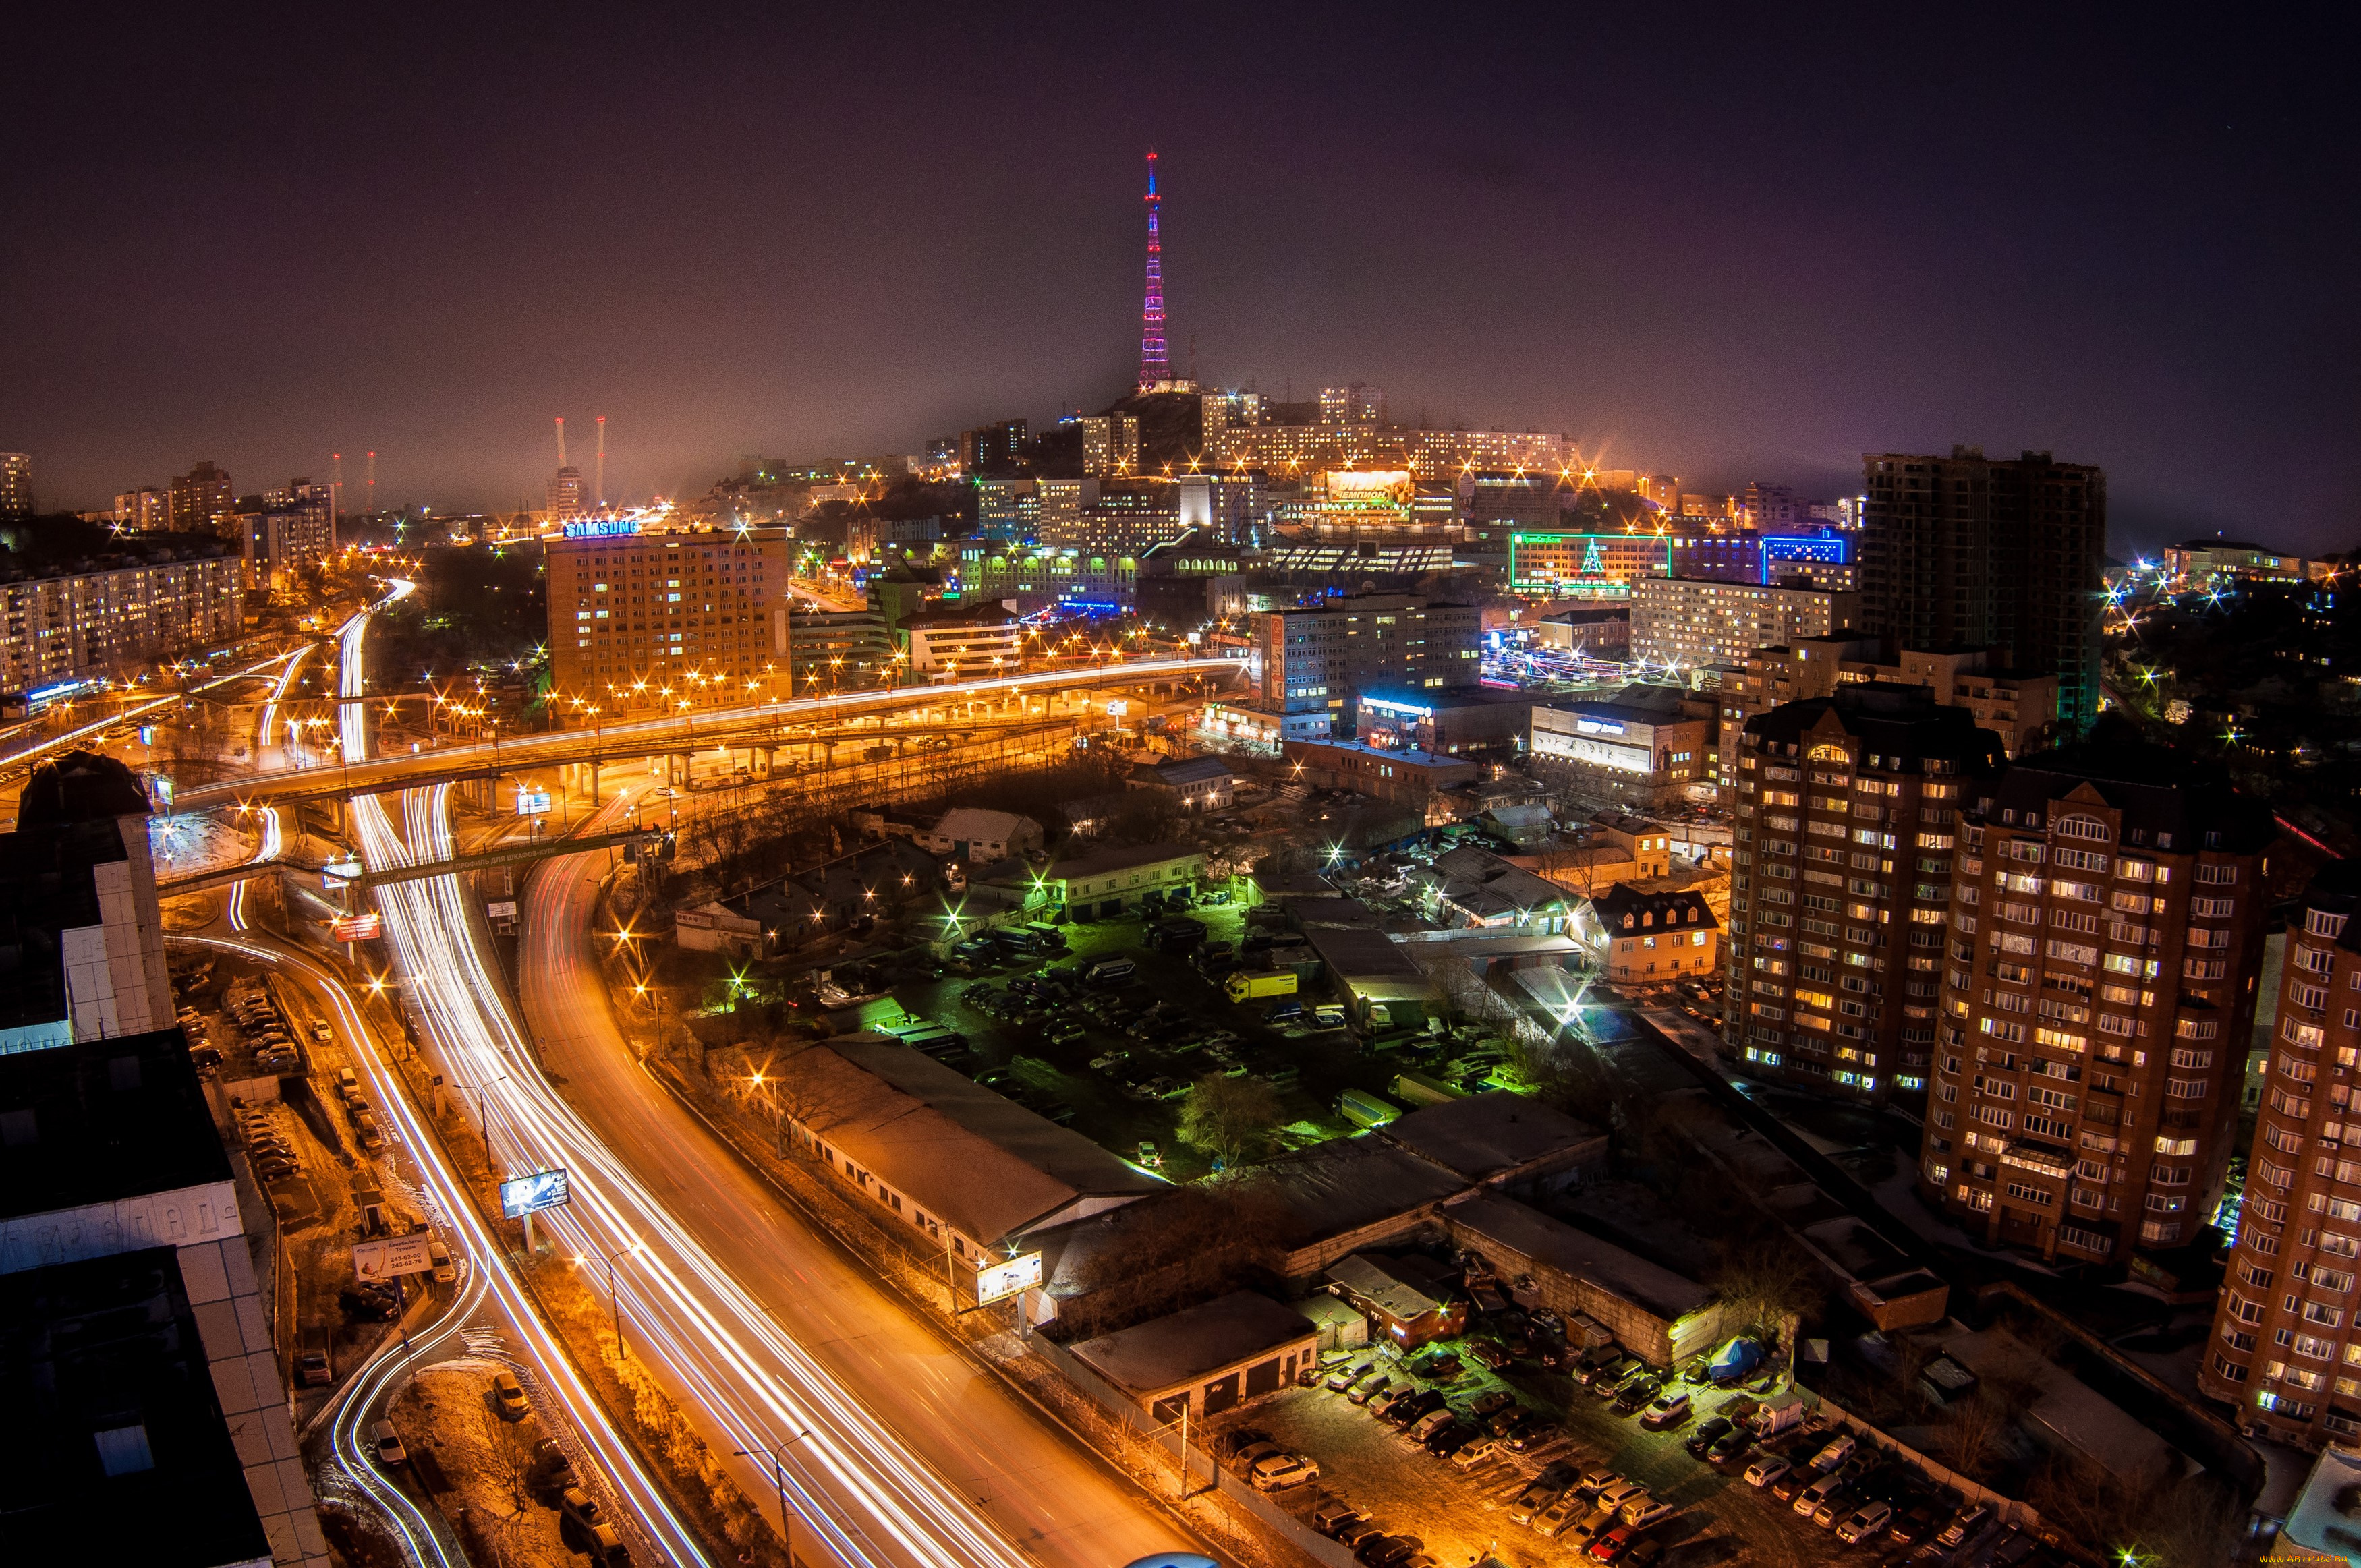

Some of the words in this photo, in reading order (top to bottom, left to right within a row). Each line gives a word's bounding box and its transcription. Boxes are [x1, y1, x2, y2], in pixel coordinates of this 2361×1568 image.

[1336, 491, 1386, 499] ЧЕМПИОН
[566, 521, 639, 538] SAMSUNG
[365, 875, 395, 885] ARISTO
[396, 863, 454, 879] АЛЮМИНИЕВЫЙ
[455, 859, 490, 870] ПРОФИЛЬ
[490, 855, 505, 865] ДЛЯ
[507, 847, 557, 861] ШКАФОВ-КУПЕ
[389, 1239, 422, 1248] Авиабилеты
[390, 1252, 422, 1262] 243-62-00
